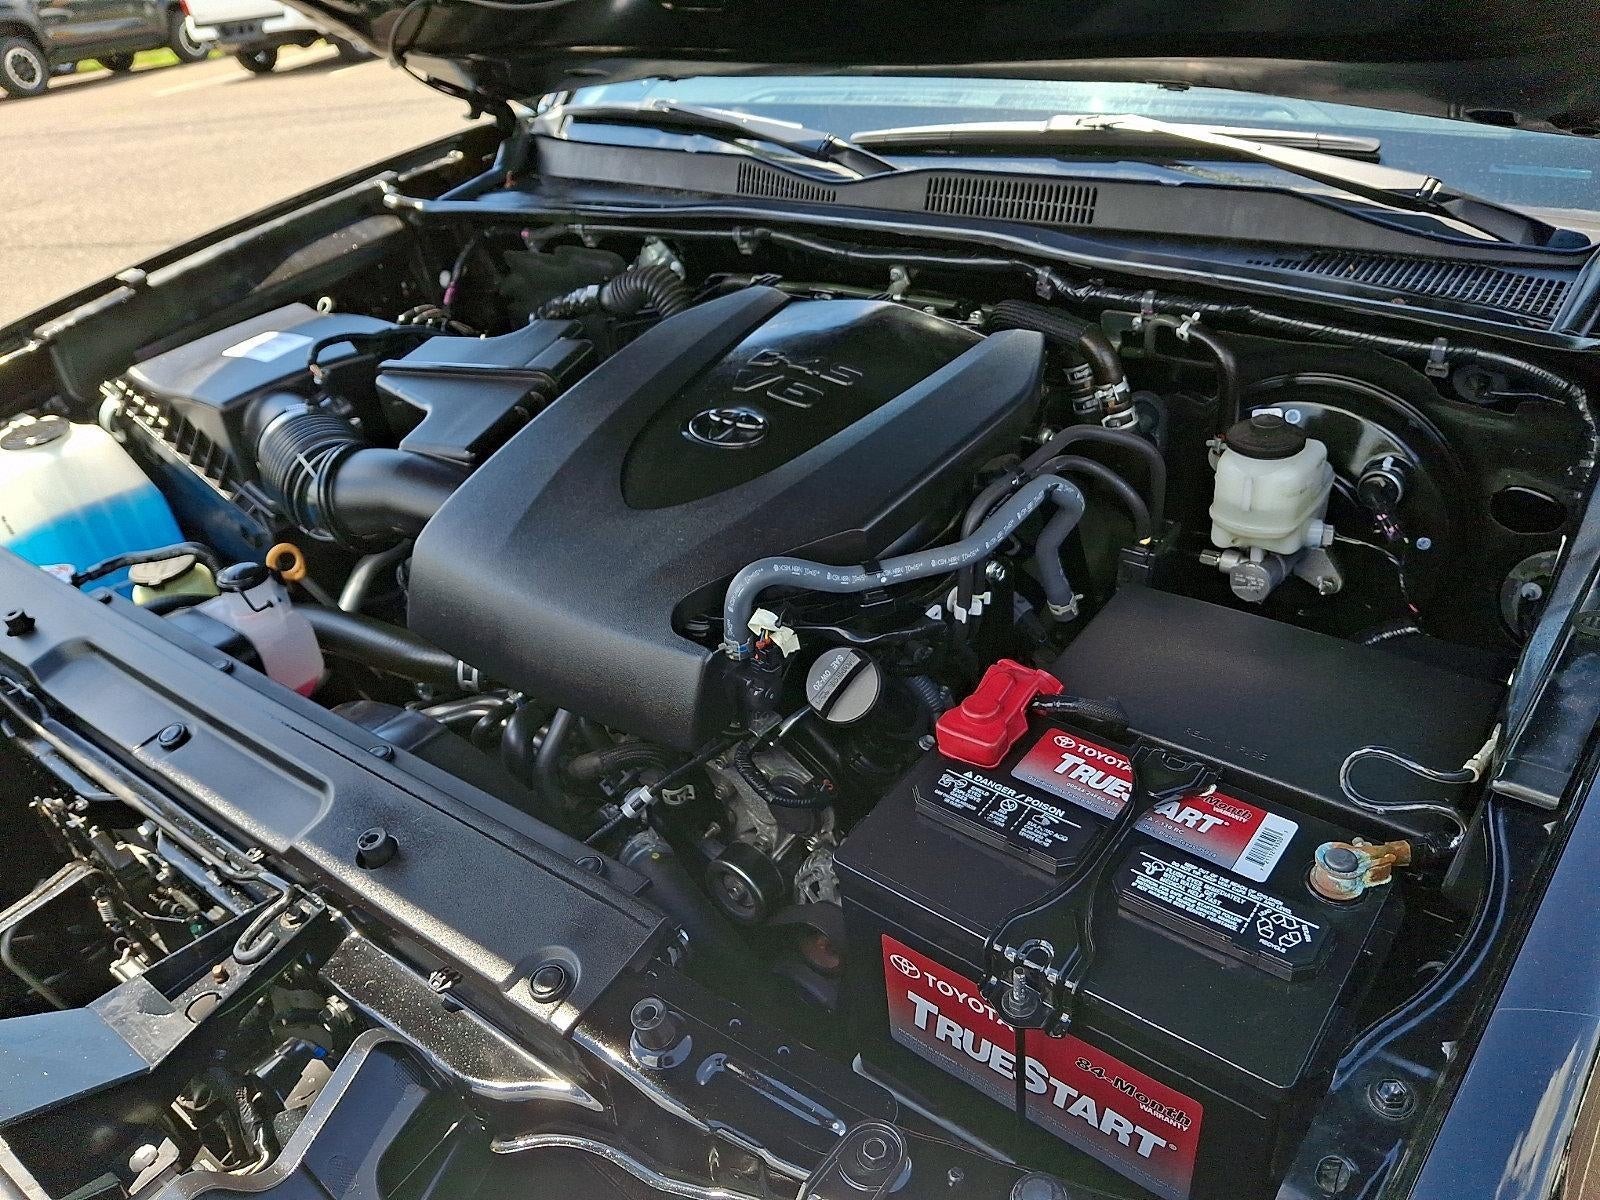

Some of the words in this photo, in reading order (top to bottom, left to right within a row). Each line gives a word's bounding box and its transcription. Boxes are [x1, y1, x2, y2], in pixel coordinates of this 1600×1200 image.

[830, 654, 844, 670] SAE
[1077, 743, 1133, 773] TOYOTA
[907, 989, 1168, 1159] TRUESTART
[1075, 1056, 1192, 1127] 84-Month
[1140, 1102, 1189, 1132] WARRANTY
